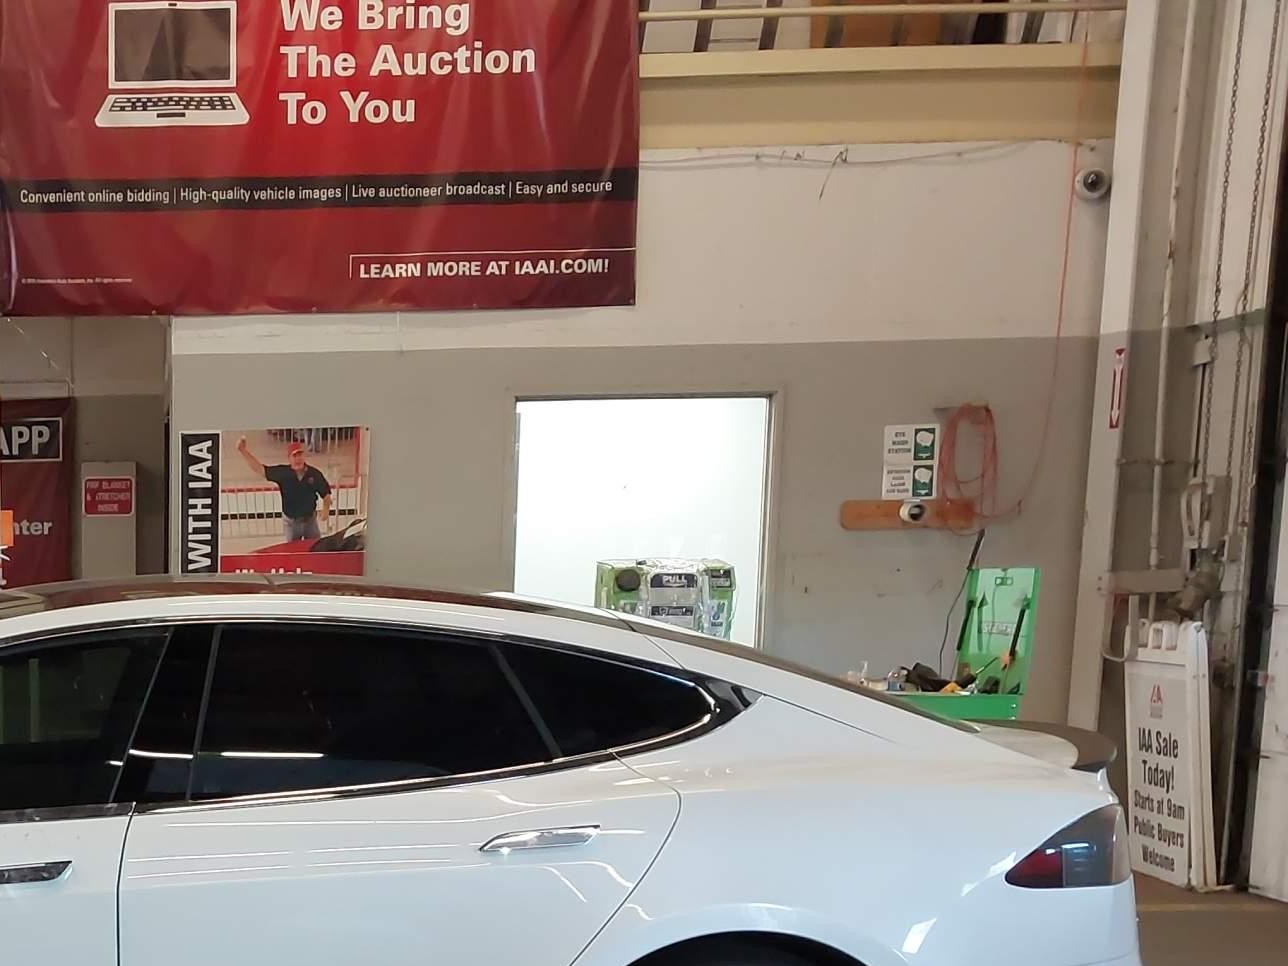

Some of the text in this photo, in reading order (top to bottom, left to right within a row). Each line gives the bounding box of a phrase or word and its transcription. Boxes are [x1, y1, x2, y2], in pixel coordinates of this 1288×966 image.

[280, 0, 470, 36] We Bring
[279, 41, 536, 78] The Auction
[278, 90, 416, 125] To You
[20, 189, 85, 204] Convenient
[88, 189, 124, 203] online
[126, 188, 170, 204] bidding
[180, 187, 251, 203] High-quality
[253, 186, 296, 200] vehicle
[298, 185, 342, 201] images
[352, 184, 376, 199] Live
[379, 183, 442, 198] auctioneer
[446, 181, 506, 196] broadcast
[516, 180, 544, 197] Easy
[546, 180, 569, 194] and
[571, 180, 613, 193] secure
[360, 258, 610, 279] LEARN MORE AT IAAI.COM!
[188, 439, 212, 571] WITH IAA
[12, 519, 53, 536] nter
[663, 574, 688, 583] PULL
[1138, 727, 1179, 759] IAA Sale
[1142, 759, 1175, 794] Today!
[1134, 789, 1185, 820] Starts at 9am
[1133, 815, 1185, 849] Public Buyers
[1141, 844, 1175, 872] Welcome
